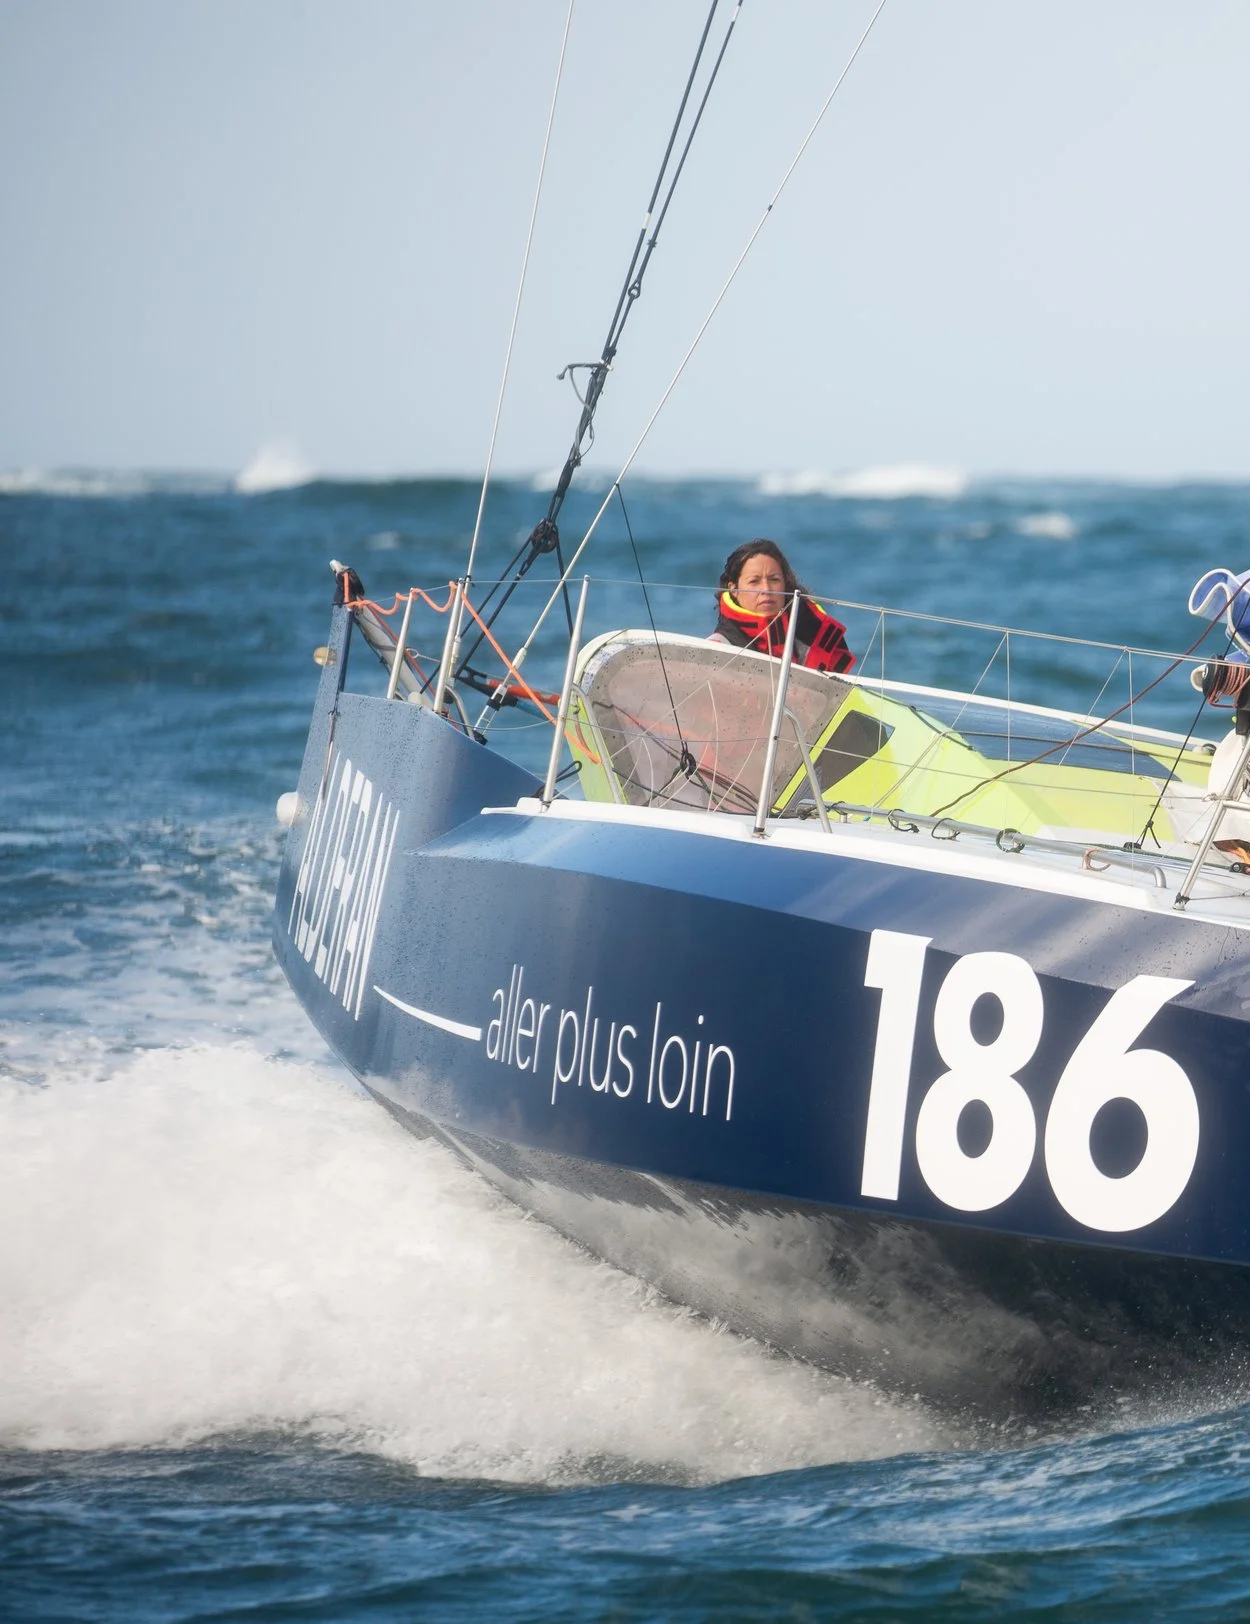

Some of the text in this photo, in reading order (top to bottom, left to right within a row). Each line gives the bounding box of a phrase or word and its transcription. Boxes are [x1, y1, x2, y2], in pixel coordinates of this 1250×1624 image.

[287, 749, 401, 1021] ALDERAN
[486, 964, 735, 1121] aller plus loin
[861, 928, 1200, 1232] 186
